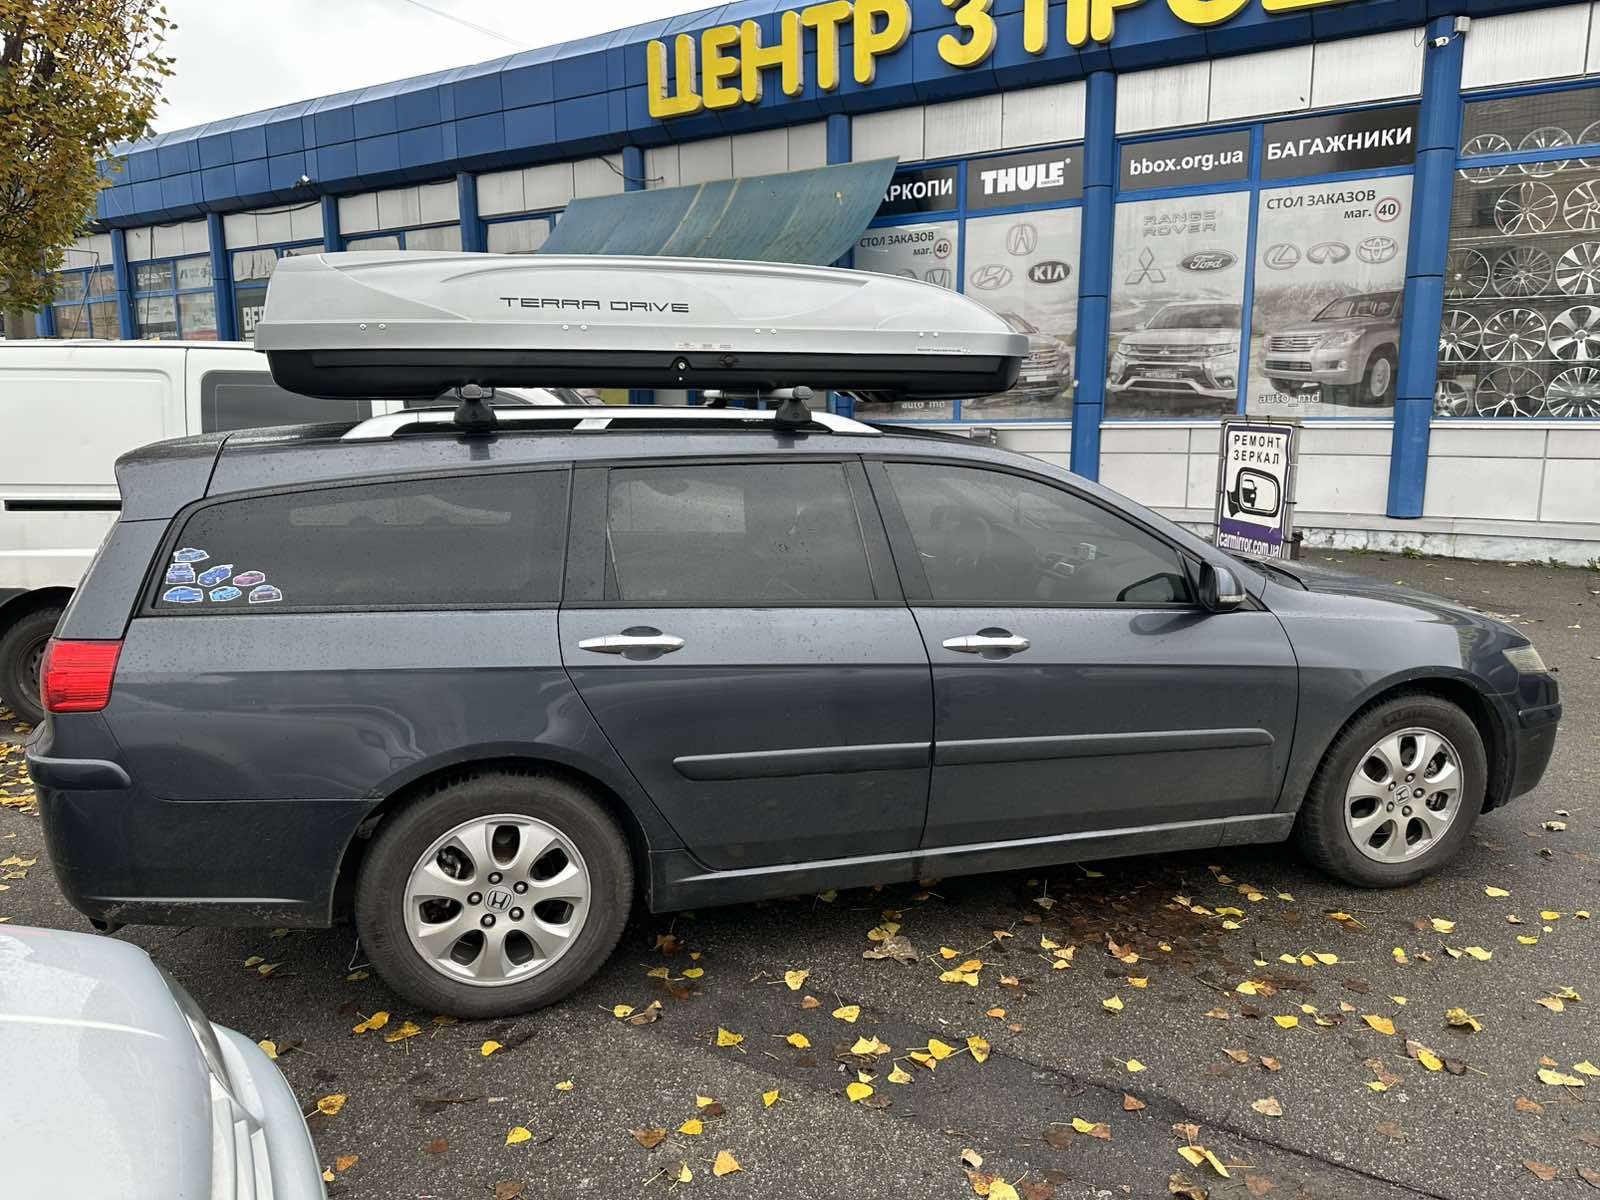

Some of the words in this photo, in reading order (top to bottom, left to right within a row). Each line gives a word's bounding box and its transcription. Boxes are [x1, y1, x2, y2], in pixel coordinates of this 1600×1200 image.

[647, 0, 910, 119] ЦЕНТР
[1267, 126, 1412, 160] БАГАЖНИКИ
[1129, 149, 1244, 176] bbox.org.ua
[980, 161, 1065, 195] THULE
[1266, 195, 1304, 210] СТОЛ
[1307, 189, 1377, 207] ЗАКАЗОВ
[1143, 210, 1217, 226] RANGE
[1344, 208, 1372, 220] маг.
[1378, 202, 1397, 216] 40
[1143, 222, 1217, 237] ROVER
[860, 235, 885, 248] СТОЛ
[887, 232, 934, 246] ЗАКАЗОВ
[912, 248, 932, 256] маг.
[936, 243, 949, 253] 40
[1190, 255, 1223, 269] Ford
[1033, 264, 1065, 281] KIA
[500, 297, 600, 310] TERRA
[610, 301, 689, 313] DRIVE
[1234, 434, 1282, 449] РЕМОНТ
[1233, 450, 1280, 465] ЗЕРКАЛ
[1219, 531, 1280, 557] carmirror.com.ua
